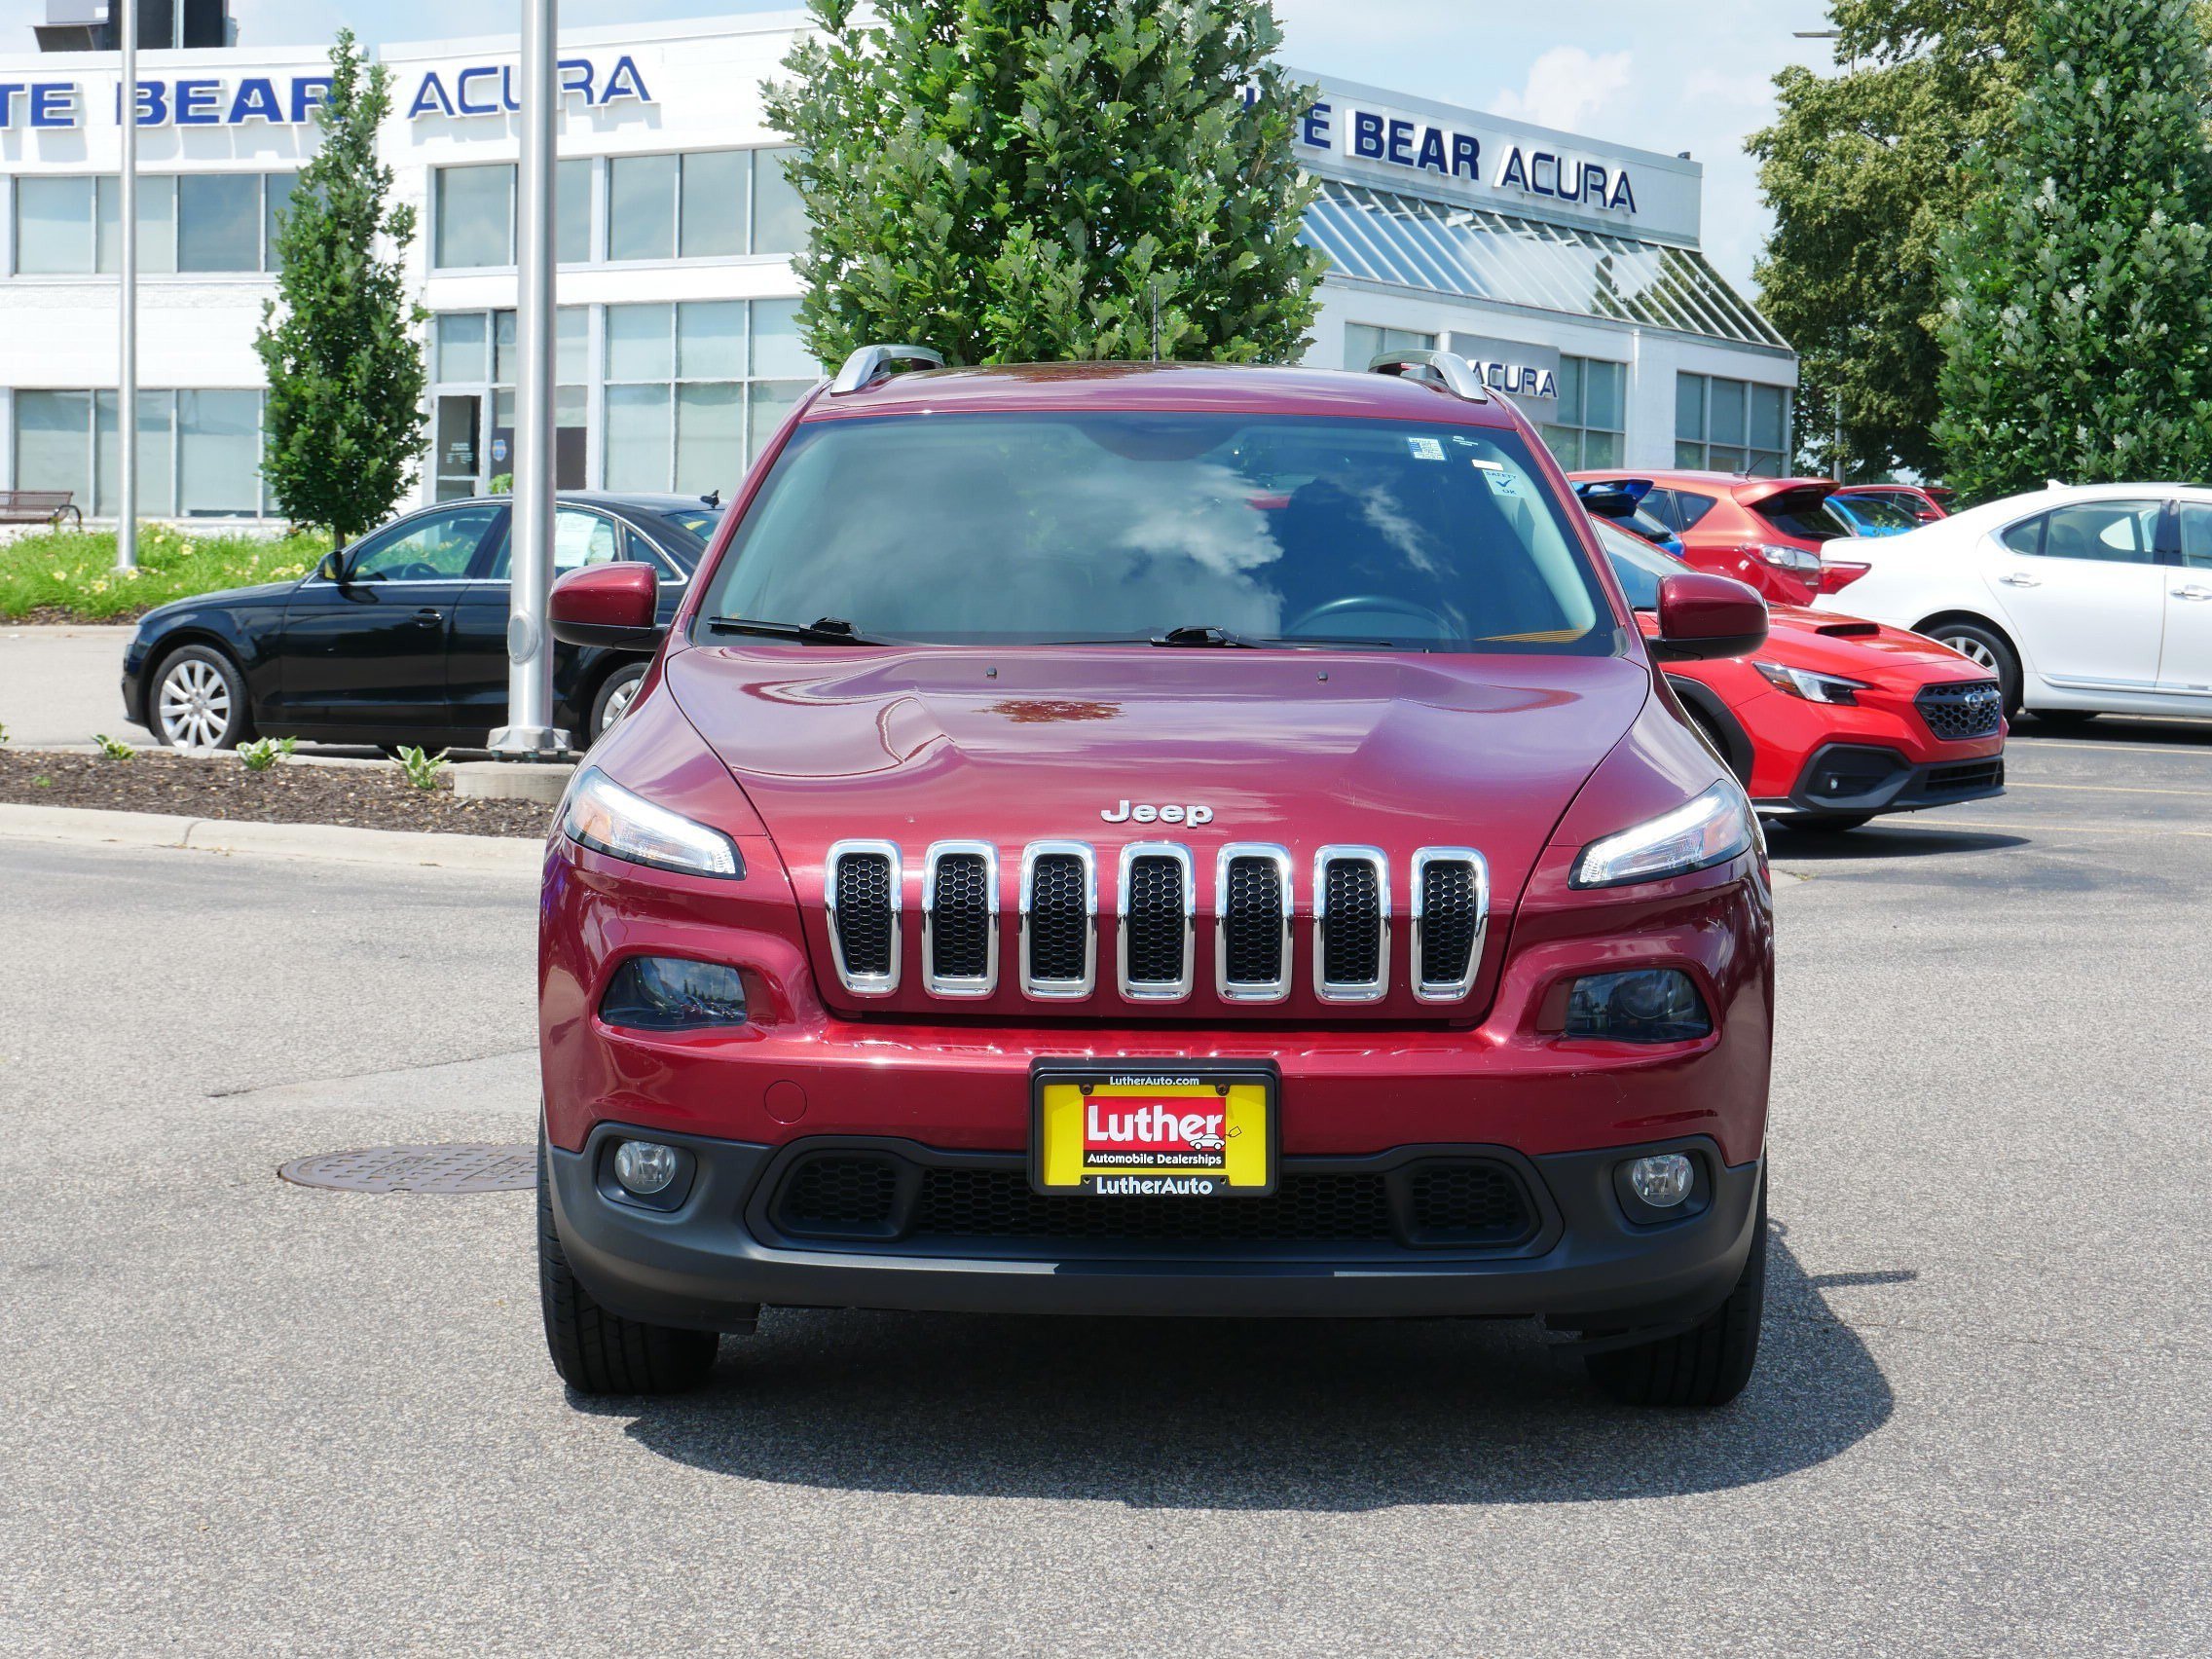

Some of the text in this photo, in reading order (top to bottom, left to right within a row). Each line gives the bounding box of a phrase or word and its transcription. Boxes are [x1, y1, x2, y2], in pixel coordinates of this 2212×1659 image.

[115, 77, 342, 126] BEAR
[1354, 110, 1481, 181] BEAR
[1501, 147, 1638, 214] ACURA
[1100, 799, 1214, 829] Jeep
[1109, 1076, 1199, 1087] LutherAuto.com
[1088, 1104, 1224, 1143] Luther
[1087, 1153, 1222, 1166] Automobile Dealerships
[1096, 1176, 1213, 1196] LutherAuto
